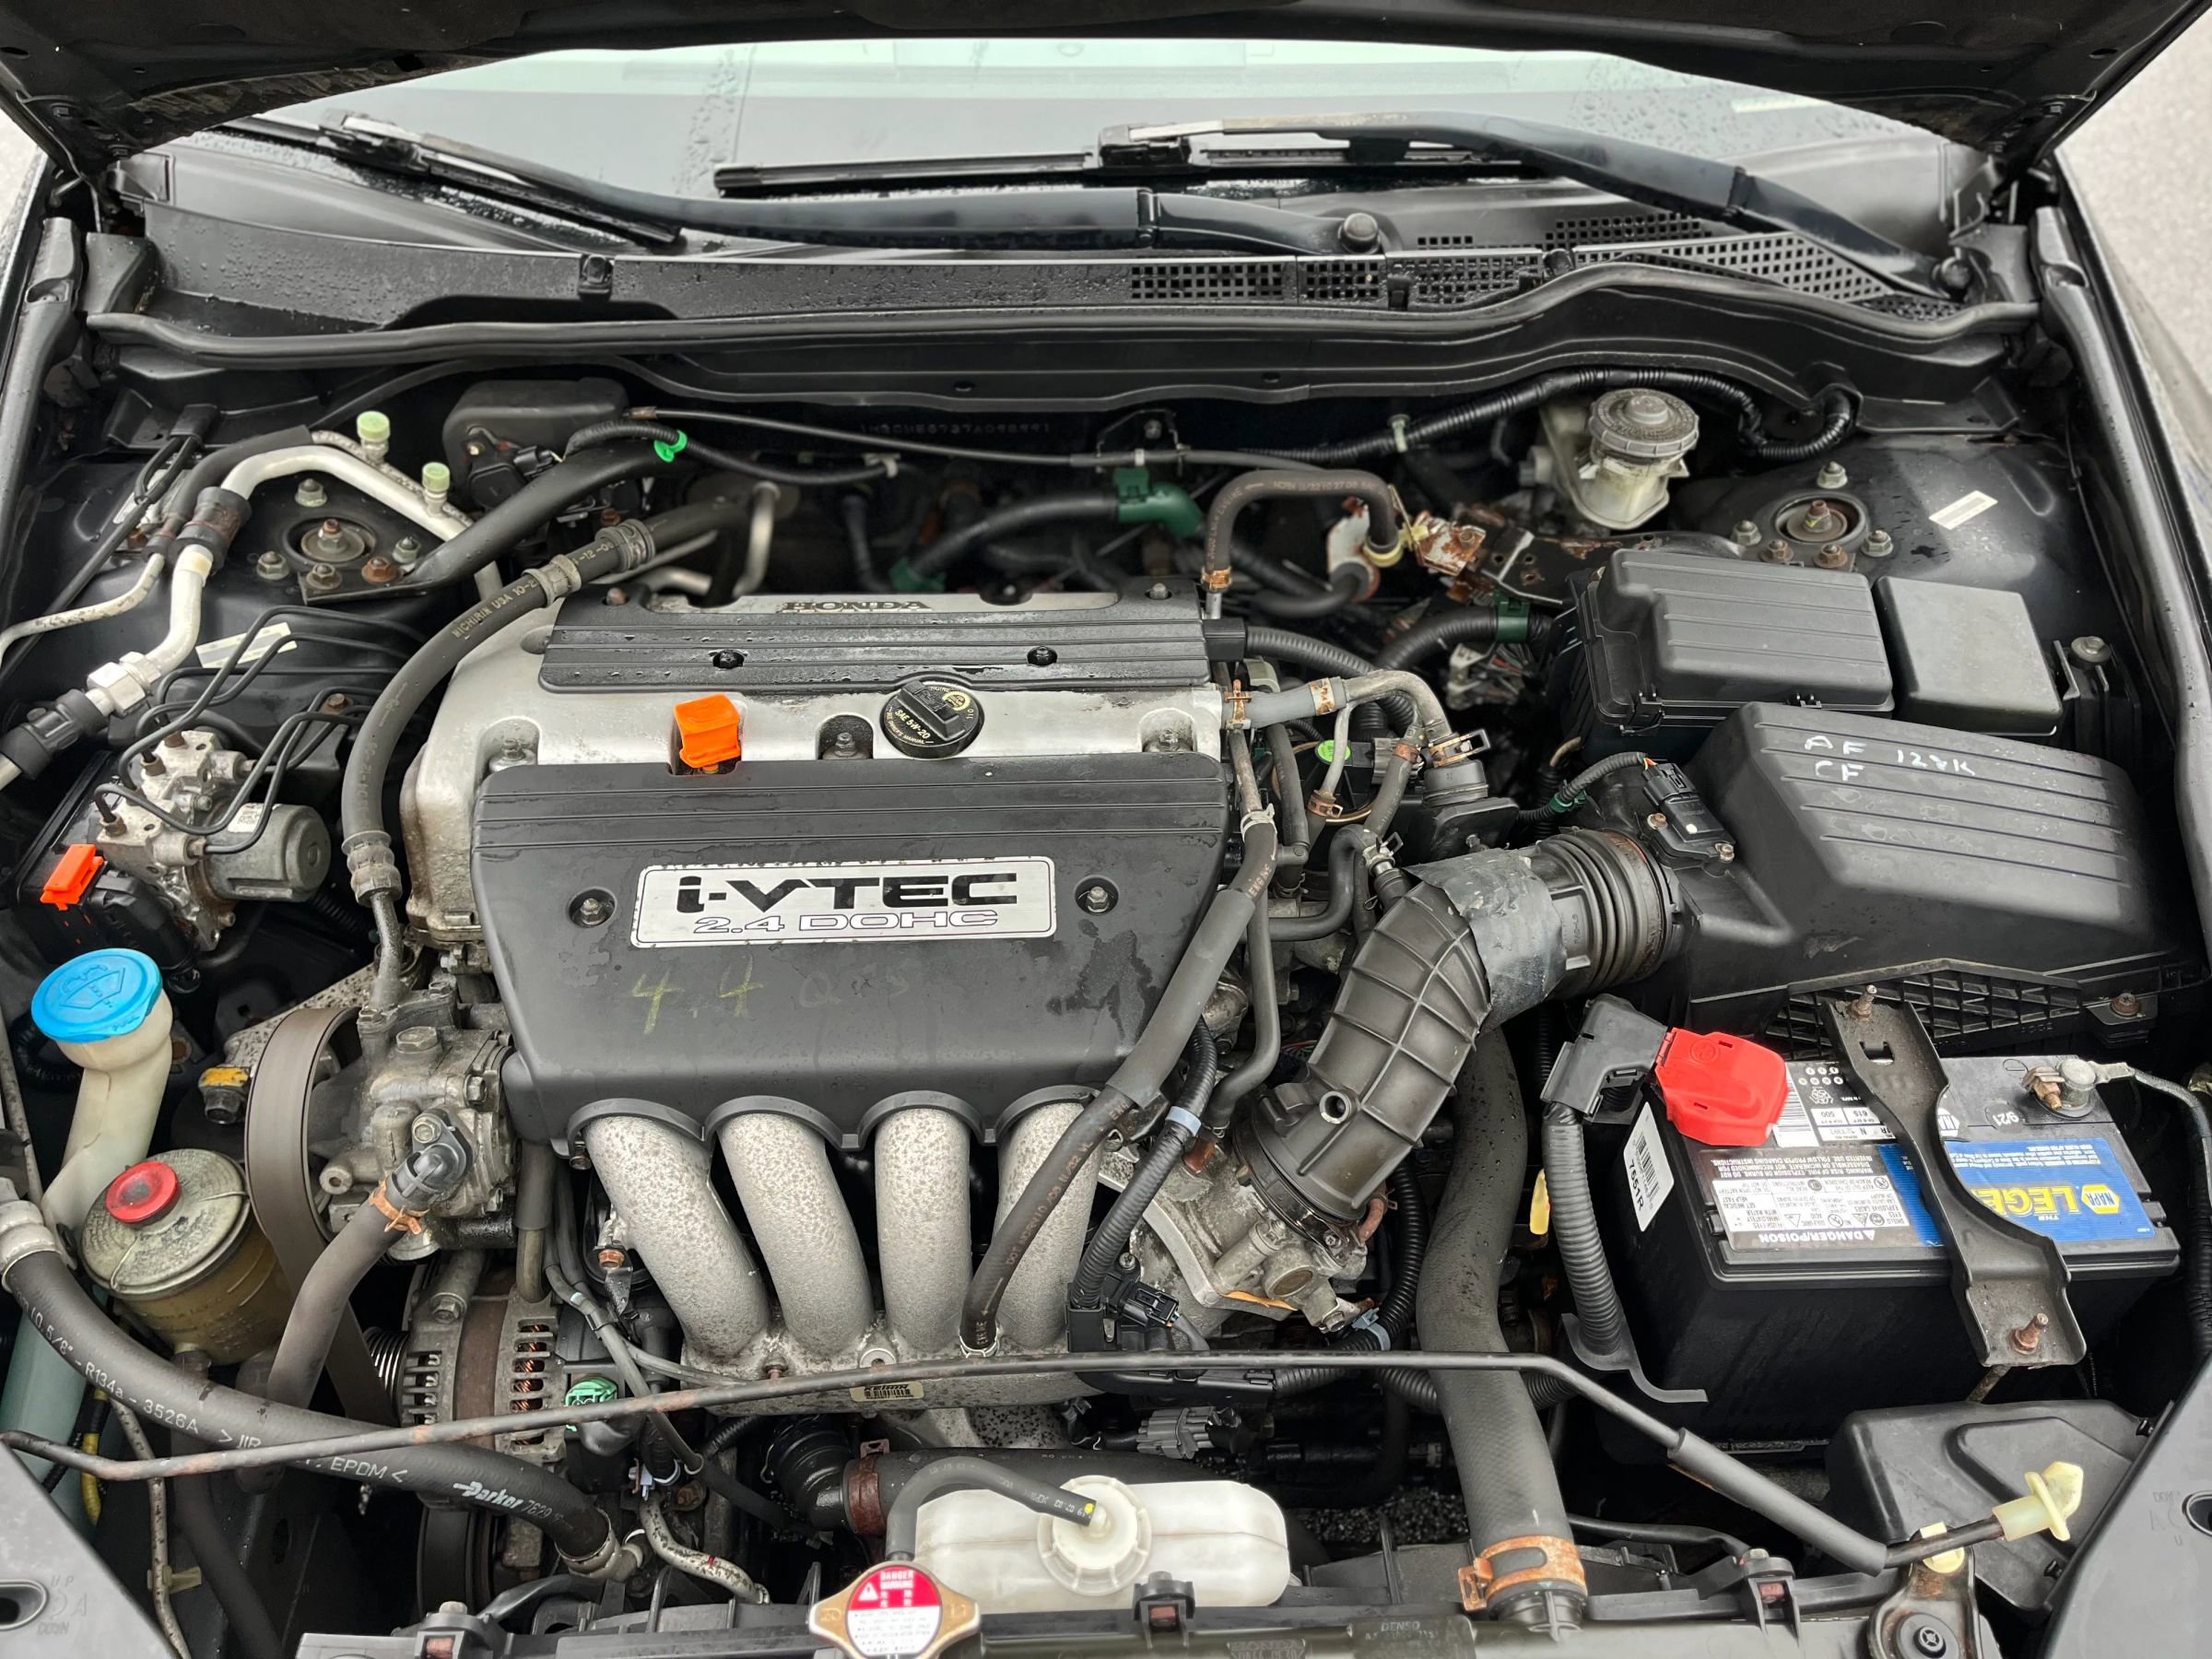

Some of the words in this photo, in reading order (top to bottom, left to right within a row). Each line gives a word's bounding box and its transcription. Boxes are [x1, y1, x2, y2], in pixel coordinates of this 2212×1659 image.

[782, 601, 931, 613] HONDA
[895, 709, 910, 721] SAE
[907, 718, 931, 739] 5W-20
[676, 872, 1018, 913] i-VTEC
[693, 914, 785, 935] 2.4
[798, 909, 998, 932] DOHC
[1993, 1111, 2019, 1125] 9/21
[1971, 1186, 2081, 1218] LEGE
[2086, 1192, 2116, 1207] NAPA
[1759, 1230, 1865, 1243] DANGER/POISON
[85, 1361, 124, 1399] R134a
[143, 1398, 200, 1435] 3526A
[330, 1456, 388, 1480] EPDM
[458, 1480, 524, 1510] Parker
[880, 1570, 913, 1581] DANGER
[880, 1581, 913, 1590] WARNING
[1381, 1620, 1420, 1631] DENSO
